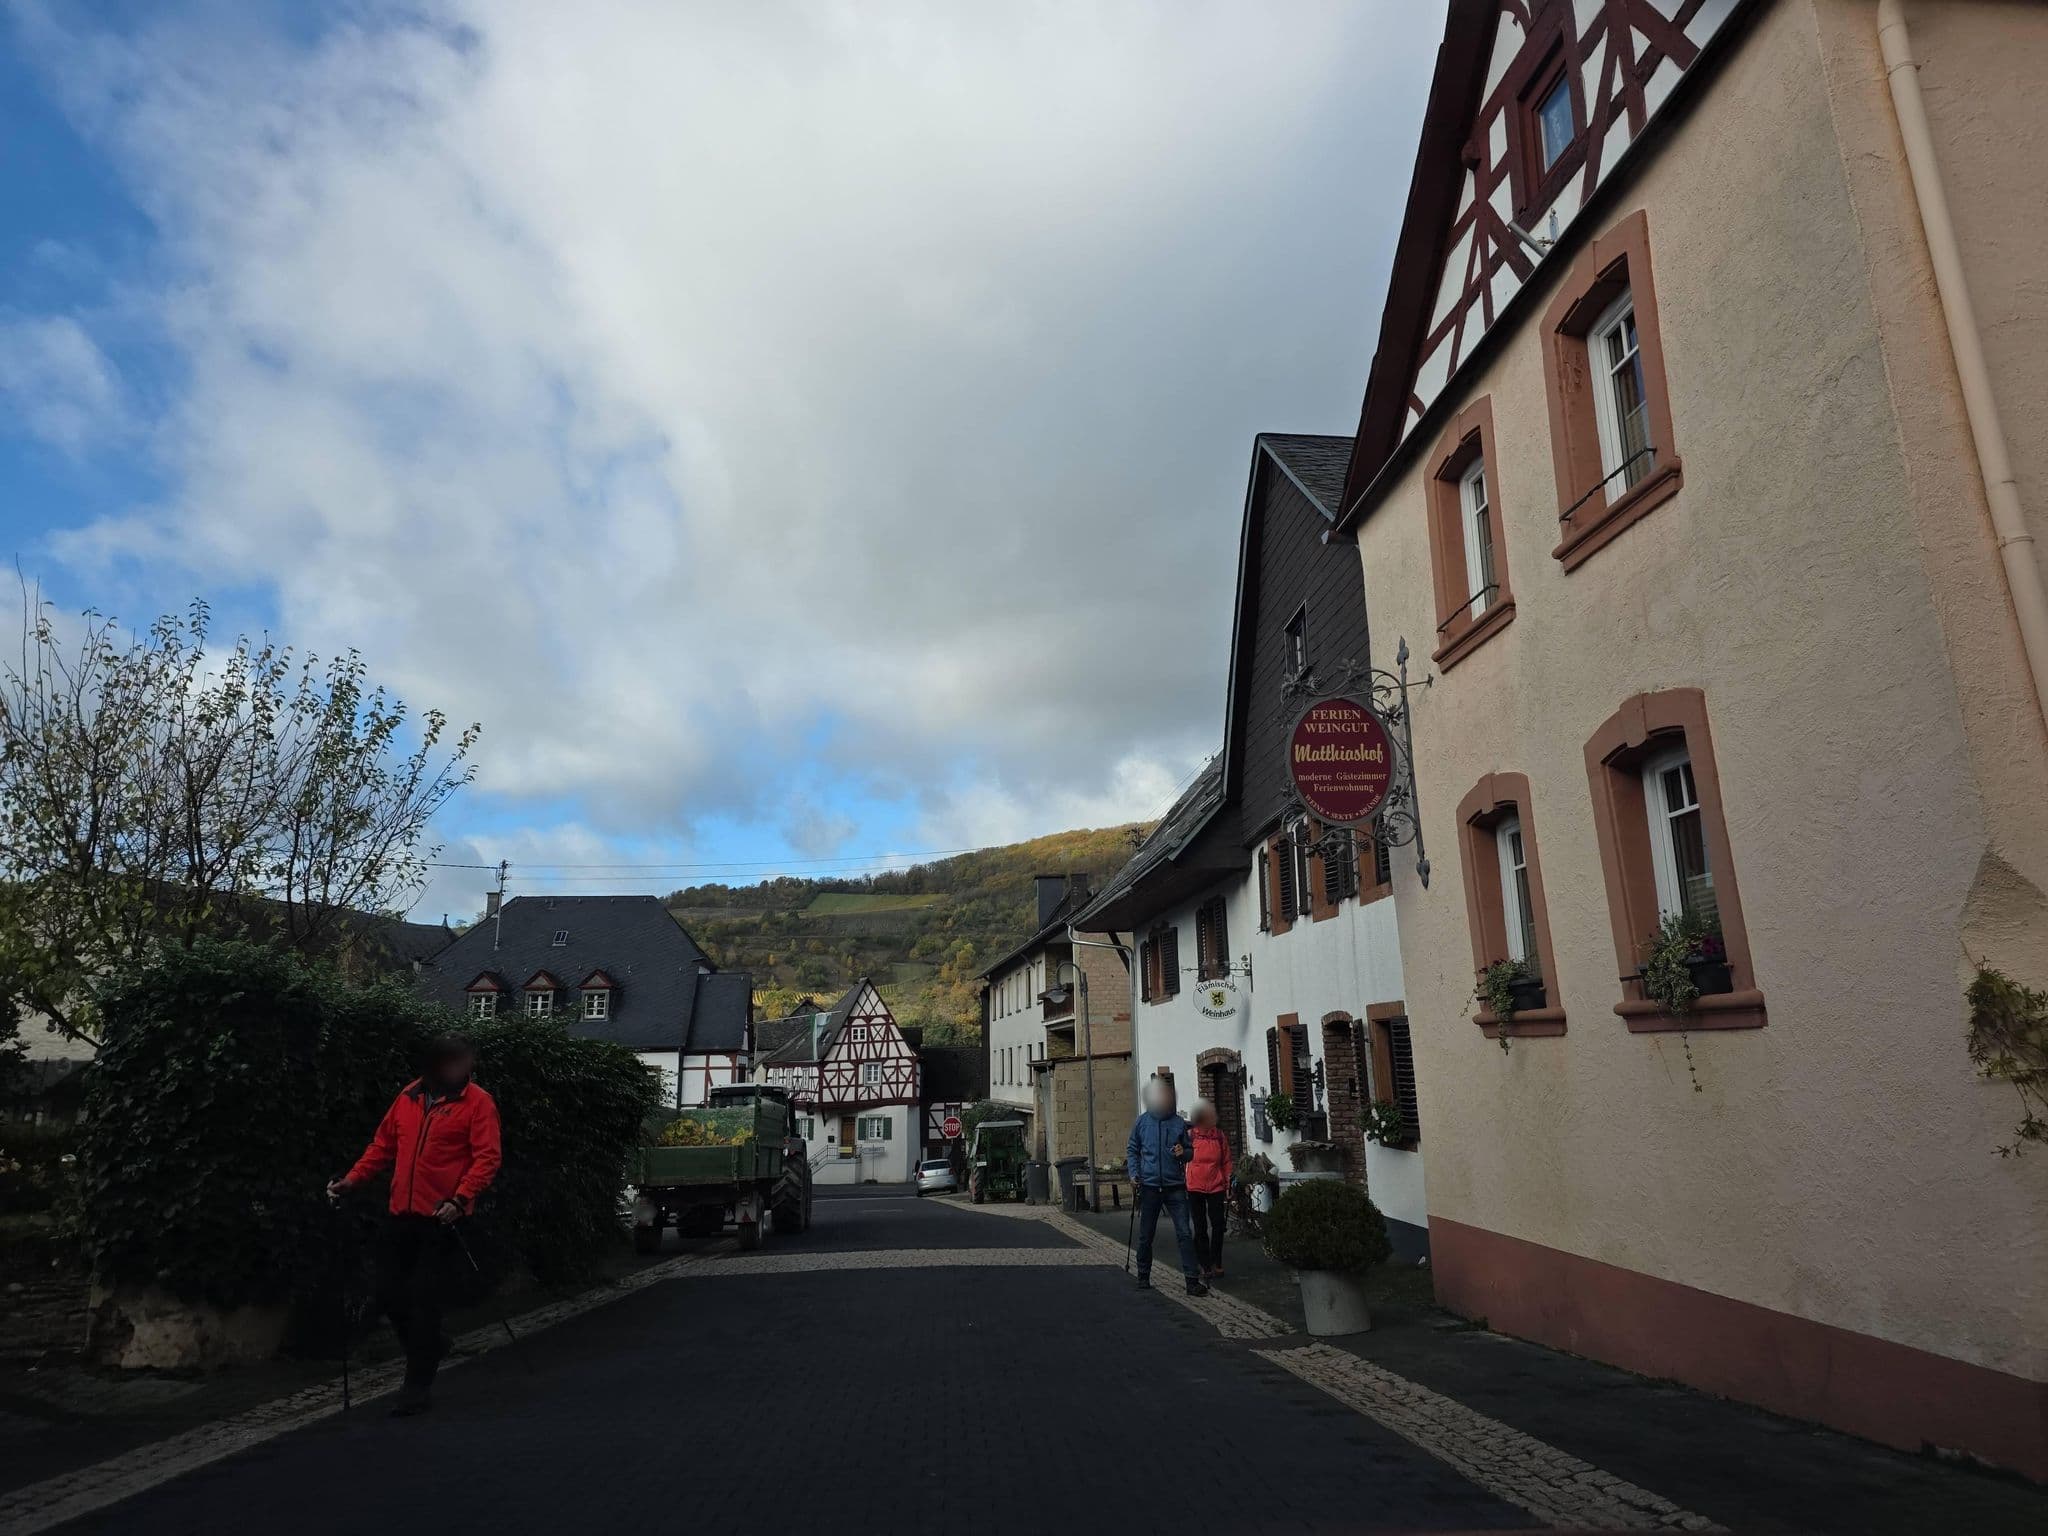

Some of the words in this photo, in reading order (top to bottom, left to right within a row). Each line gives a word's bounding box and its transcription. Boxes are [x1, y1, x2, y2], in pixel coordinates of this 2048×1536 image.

[1312, 709, 1361, 720] FERIEN
[1305, 722, 1370, 733] WEINGUT
[1295, 743, 1383, 763] Matthiashof
[1298, 772, 1332, 781] moderne
[1336, 771, 1387, 781] Gästezimmer
[1313, 783, 1374, 792] Ferienwohnung
[1197, 981, 1237, 994] Flämisches
[1202, 1007, 1236, 1017] Weinhaus
[944, 1123, 960, 1132] STOP
